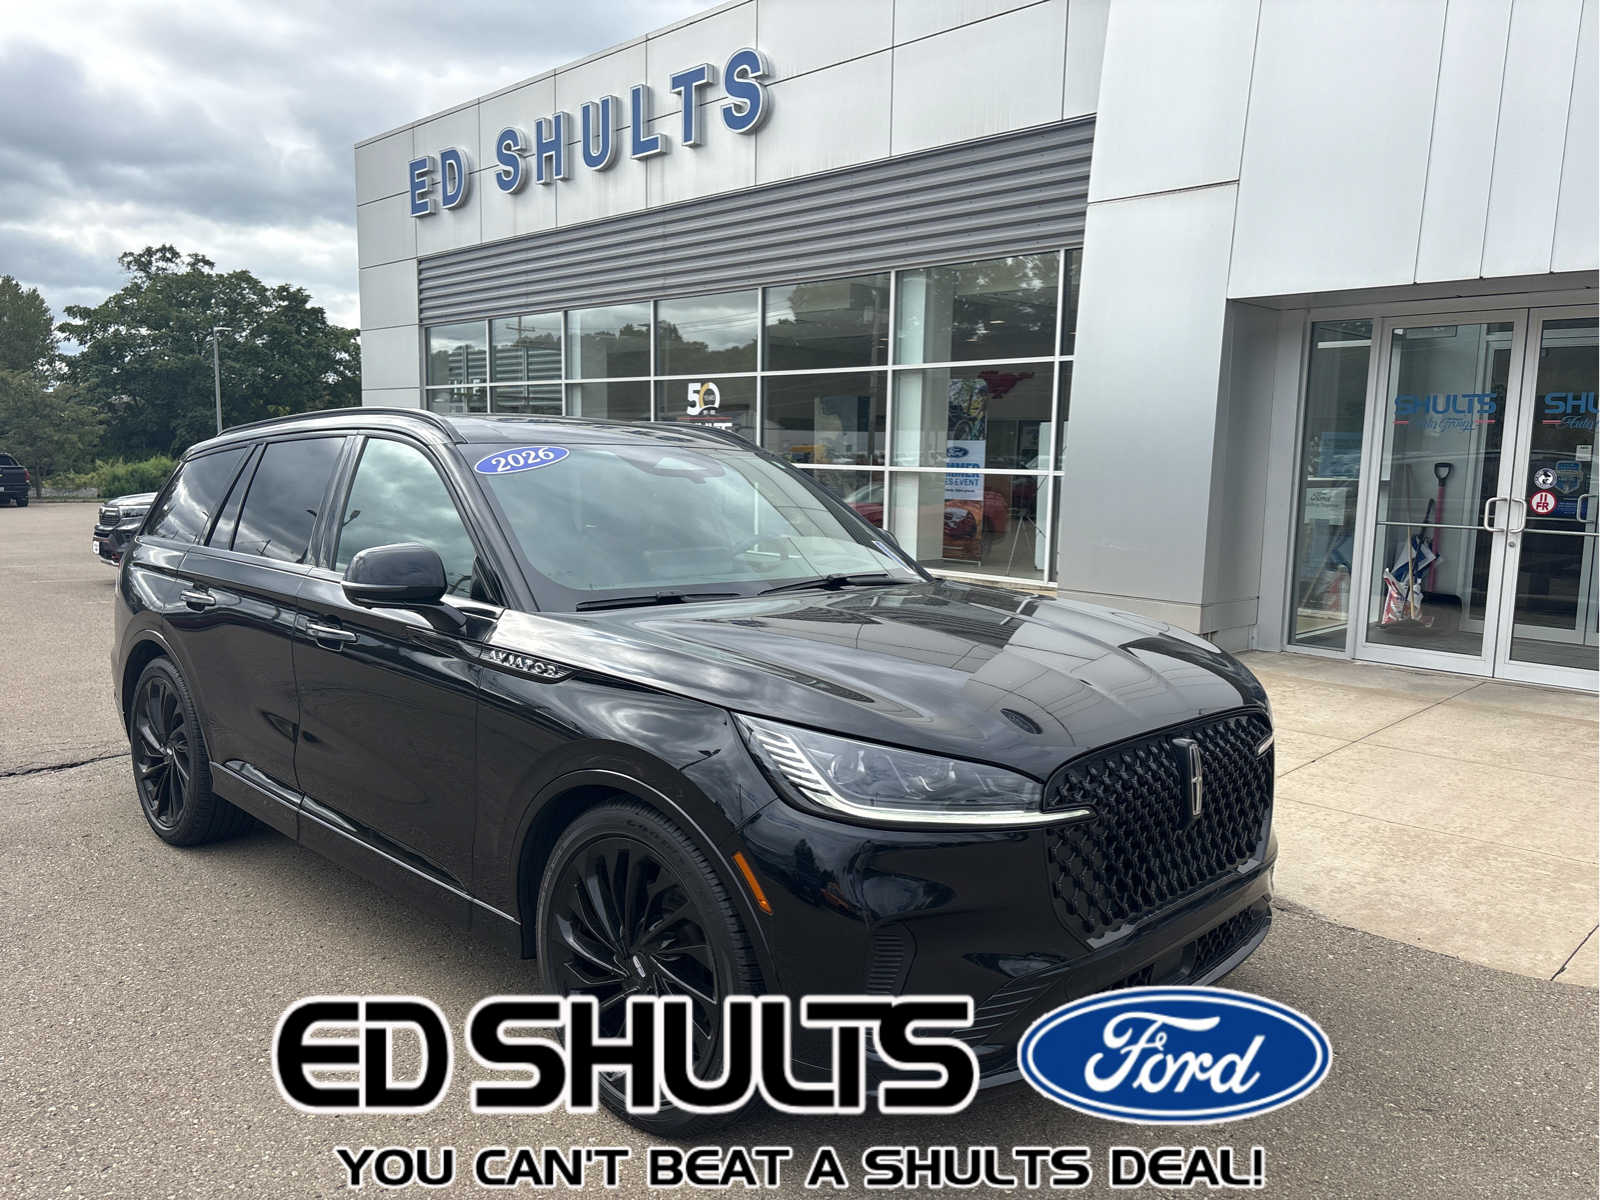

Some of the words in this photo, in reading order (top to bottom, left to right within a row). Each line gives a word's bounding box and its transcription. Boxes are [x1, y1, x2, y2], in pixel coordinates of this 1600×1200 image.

[409, 146, 470, 218] ED
[495, 47, 771, 194] SHULTS
[1394, 392, 1497, 415] SHULTS
[491, 447, 555, 473] 2026
[954, 478, 979, 487] EVENT
[1535, 501, 1549, 511] FR
